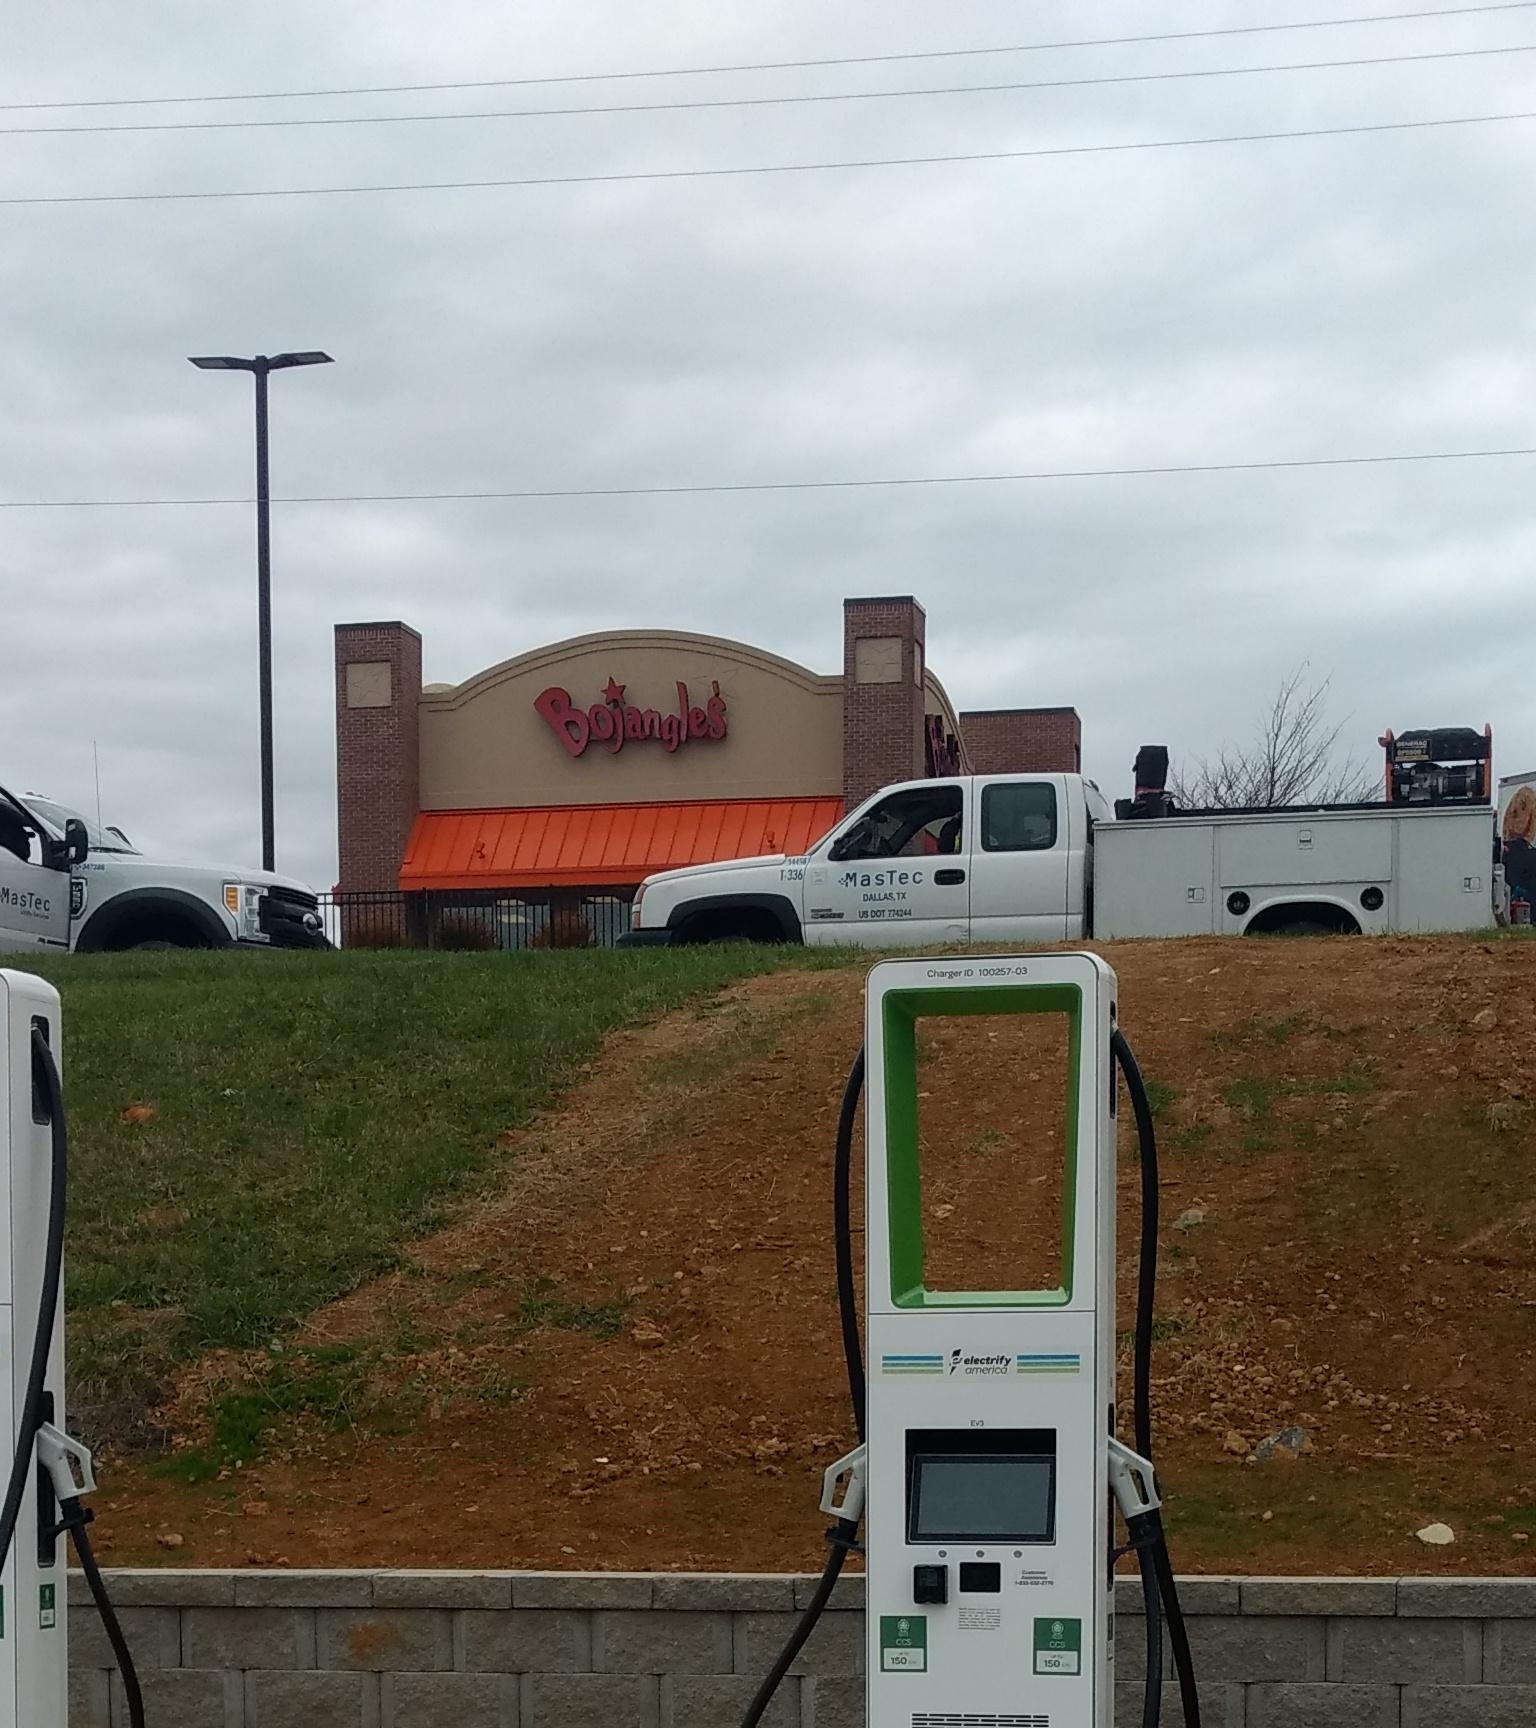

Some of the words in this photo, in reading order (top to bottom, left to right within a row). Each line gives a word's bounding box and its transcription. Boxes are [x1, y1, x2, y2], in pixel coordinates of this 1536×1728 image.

[844, 869, 924, 888] MasTec
[0, 886, 51, 912] MasTec
[927, 969, 962, 979] Charger
[964, 968, 974, 977] ID
[979, 966, 1028, 976] 100257-03
[963, 1355, 1012, 1367] electrify
[965, 1365, 1008, 1375] america
[890, 1656, 907, 1665] 150
[1044, 1660, 1061, 1668] 150
